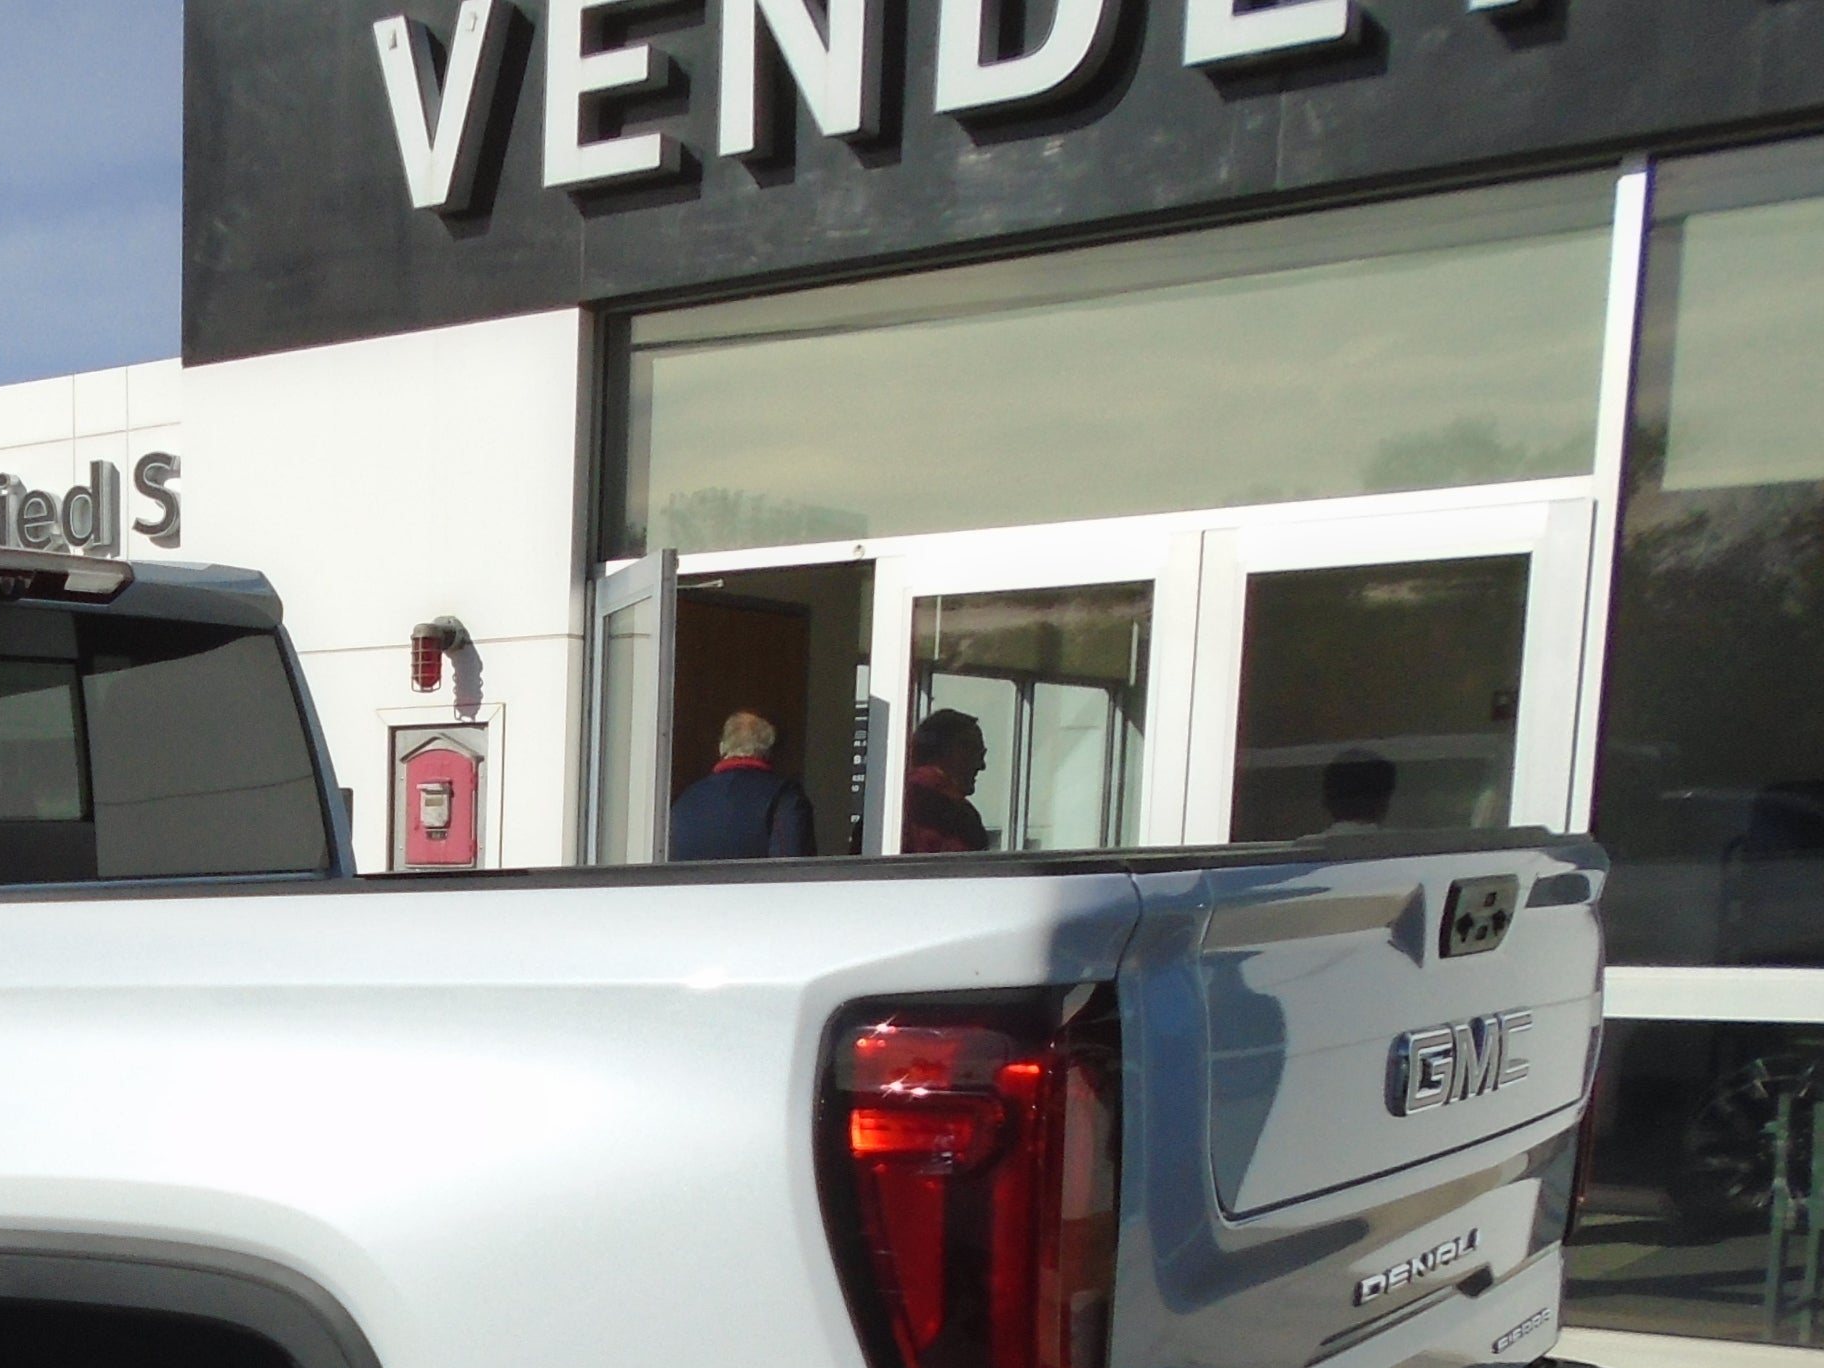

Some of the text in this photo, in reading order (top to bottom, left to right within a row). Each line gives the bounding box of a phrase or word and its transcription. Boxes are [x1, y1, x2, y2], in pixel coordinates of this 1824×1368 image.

[372, 0, 1520, 209] VEND
[1388, 1007, 1533, 1116] GMC
[1354, 1228, 1481, 1306] DENALI
[1493, 1307, 1552, 1353] SIERRA
